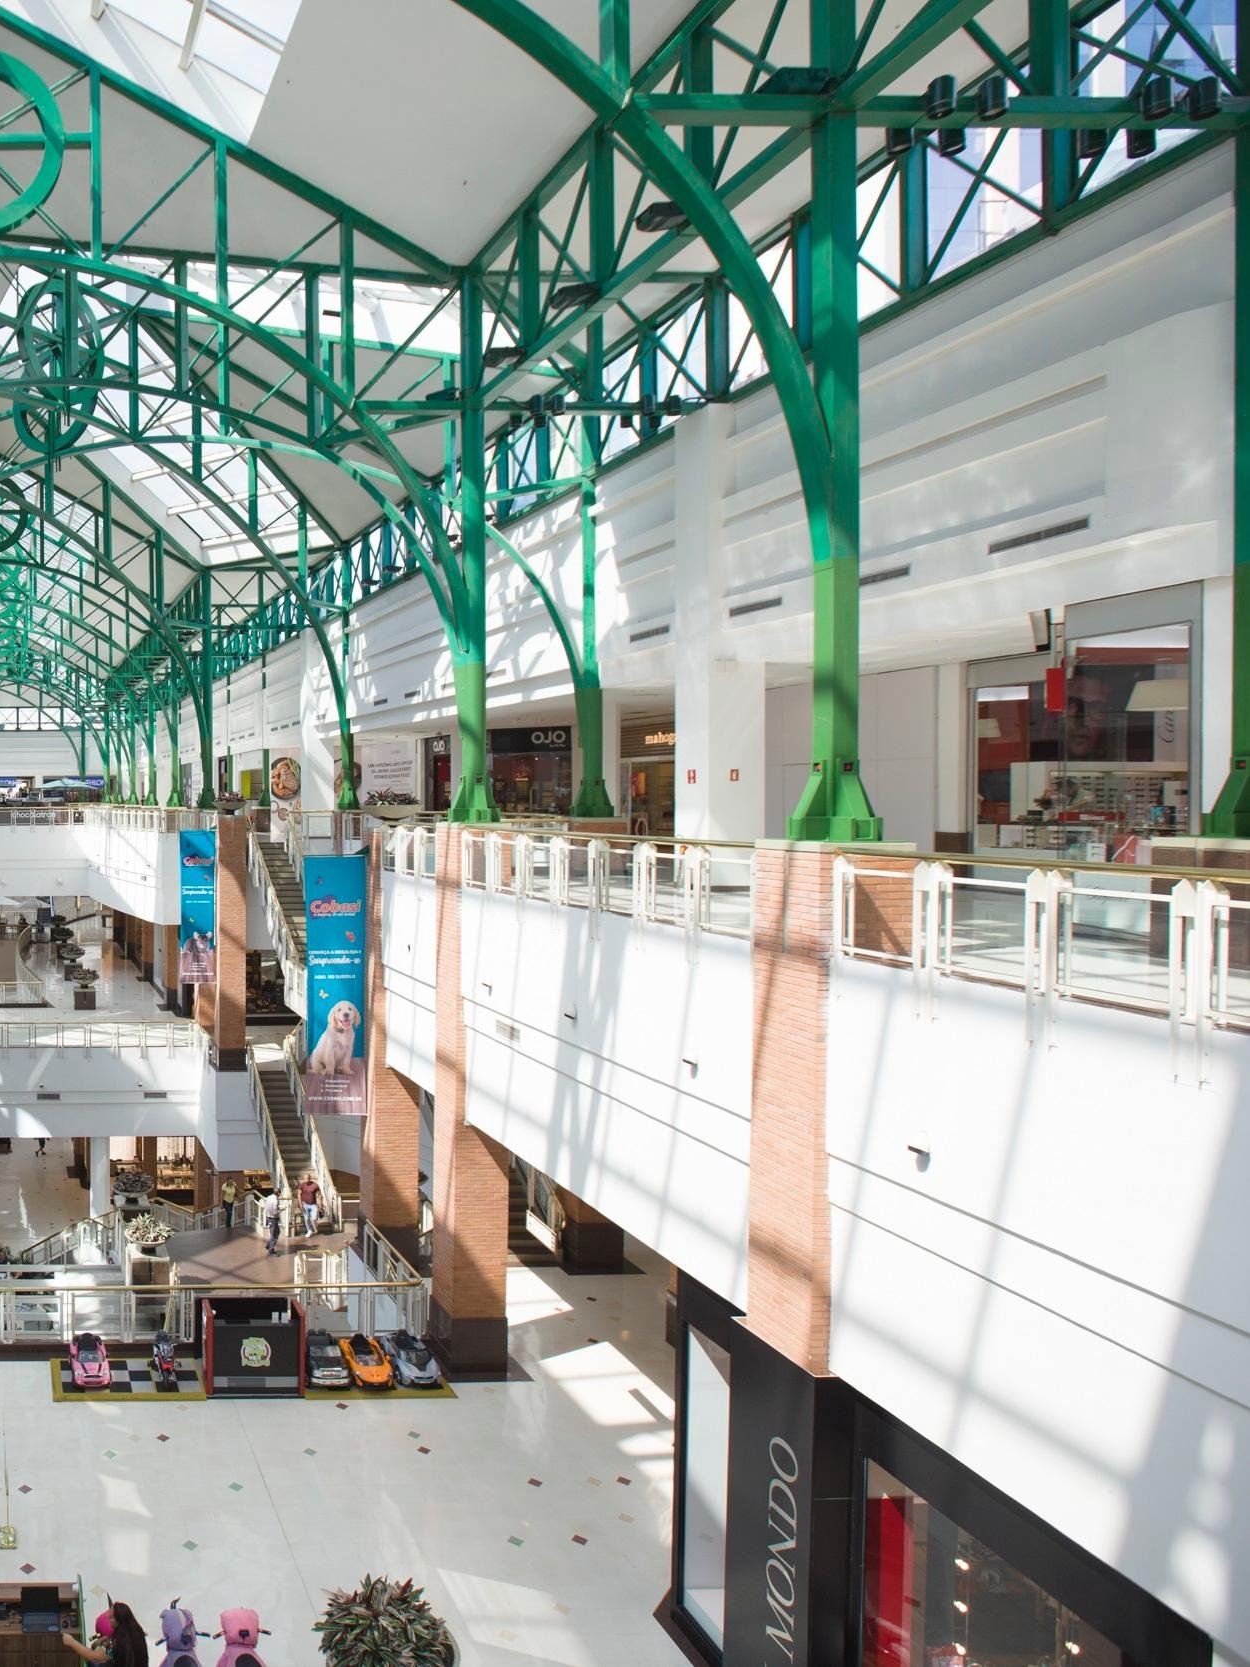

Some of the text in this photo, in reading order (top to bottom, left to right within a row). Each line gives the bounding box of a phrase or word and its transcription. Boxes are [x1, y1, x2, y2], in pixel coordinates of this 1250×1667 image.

[531, 731, 566, 744] OJO
[310, 899, 362, 913] Cobasi
[309, 955, 361, 967] Surpreenda-se
[765, 1436, 799, 1665] MONDO
